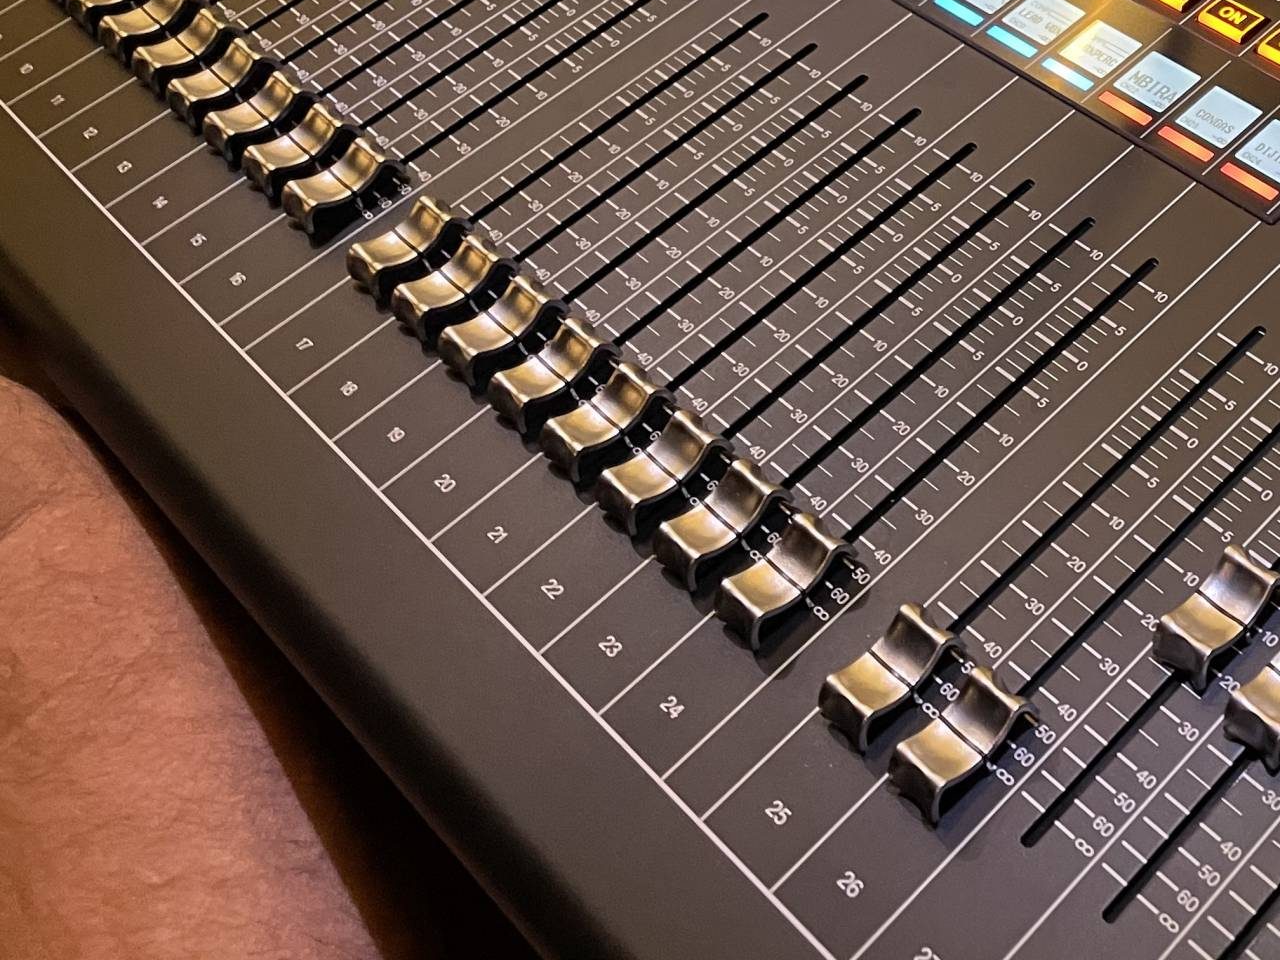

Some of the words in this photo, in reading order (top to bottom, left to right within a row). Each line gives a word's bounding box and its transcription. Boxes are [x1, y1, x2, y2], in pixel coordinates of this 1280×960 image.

[1130, 70, 1178, 103] MBIRA
[1196, 109, 1235, 134] CONGAS
[1262, 362, 1280, 377] 10
[339, 381, 359, 396] 18
[1225, 398, 1236, 412] 5
[1186, 437, 1199, 450] 0
[434, 474, 456, 493] 20
[487, 526, 508, 544] 21
[541, 578, 565, 601] 22
[599, 636, 623, 658] 23
[660, 696, 685, 719] 24
[1135, 769, 1158, 790] 40
[765, 800, 792, 825] 25
[1113, 792, 1137, 813] 50
[836, 871, 864, 898] 26
